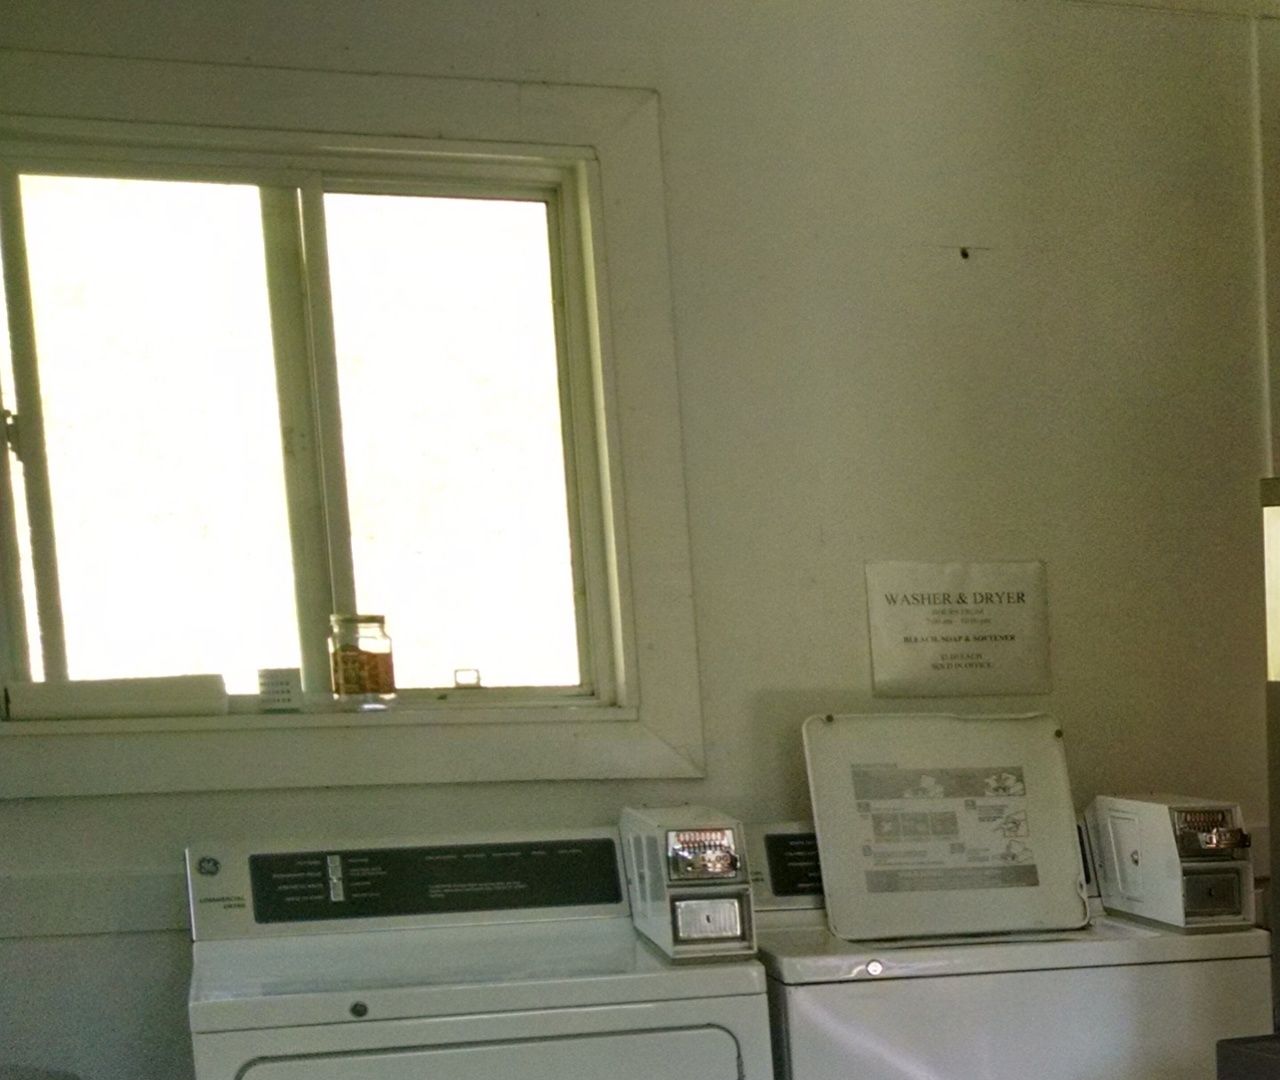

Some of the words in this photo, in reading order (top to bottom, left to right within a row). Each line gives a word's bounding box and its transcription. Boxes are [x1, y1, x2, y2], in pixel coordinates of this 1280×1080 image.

[884, 592, 952, 606] WASHER
[956, 592, 968, 605] &
[973, 591, 1026, 605] DRYER
